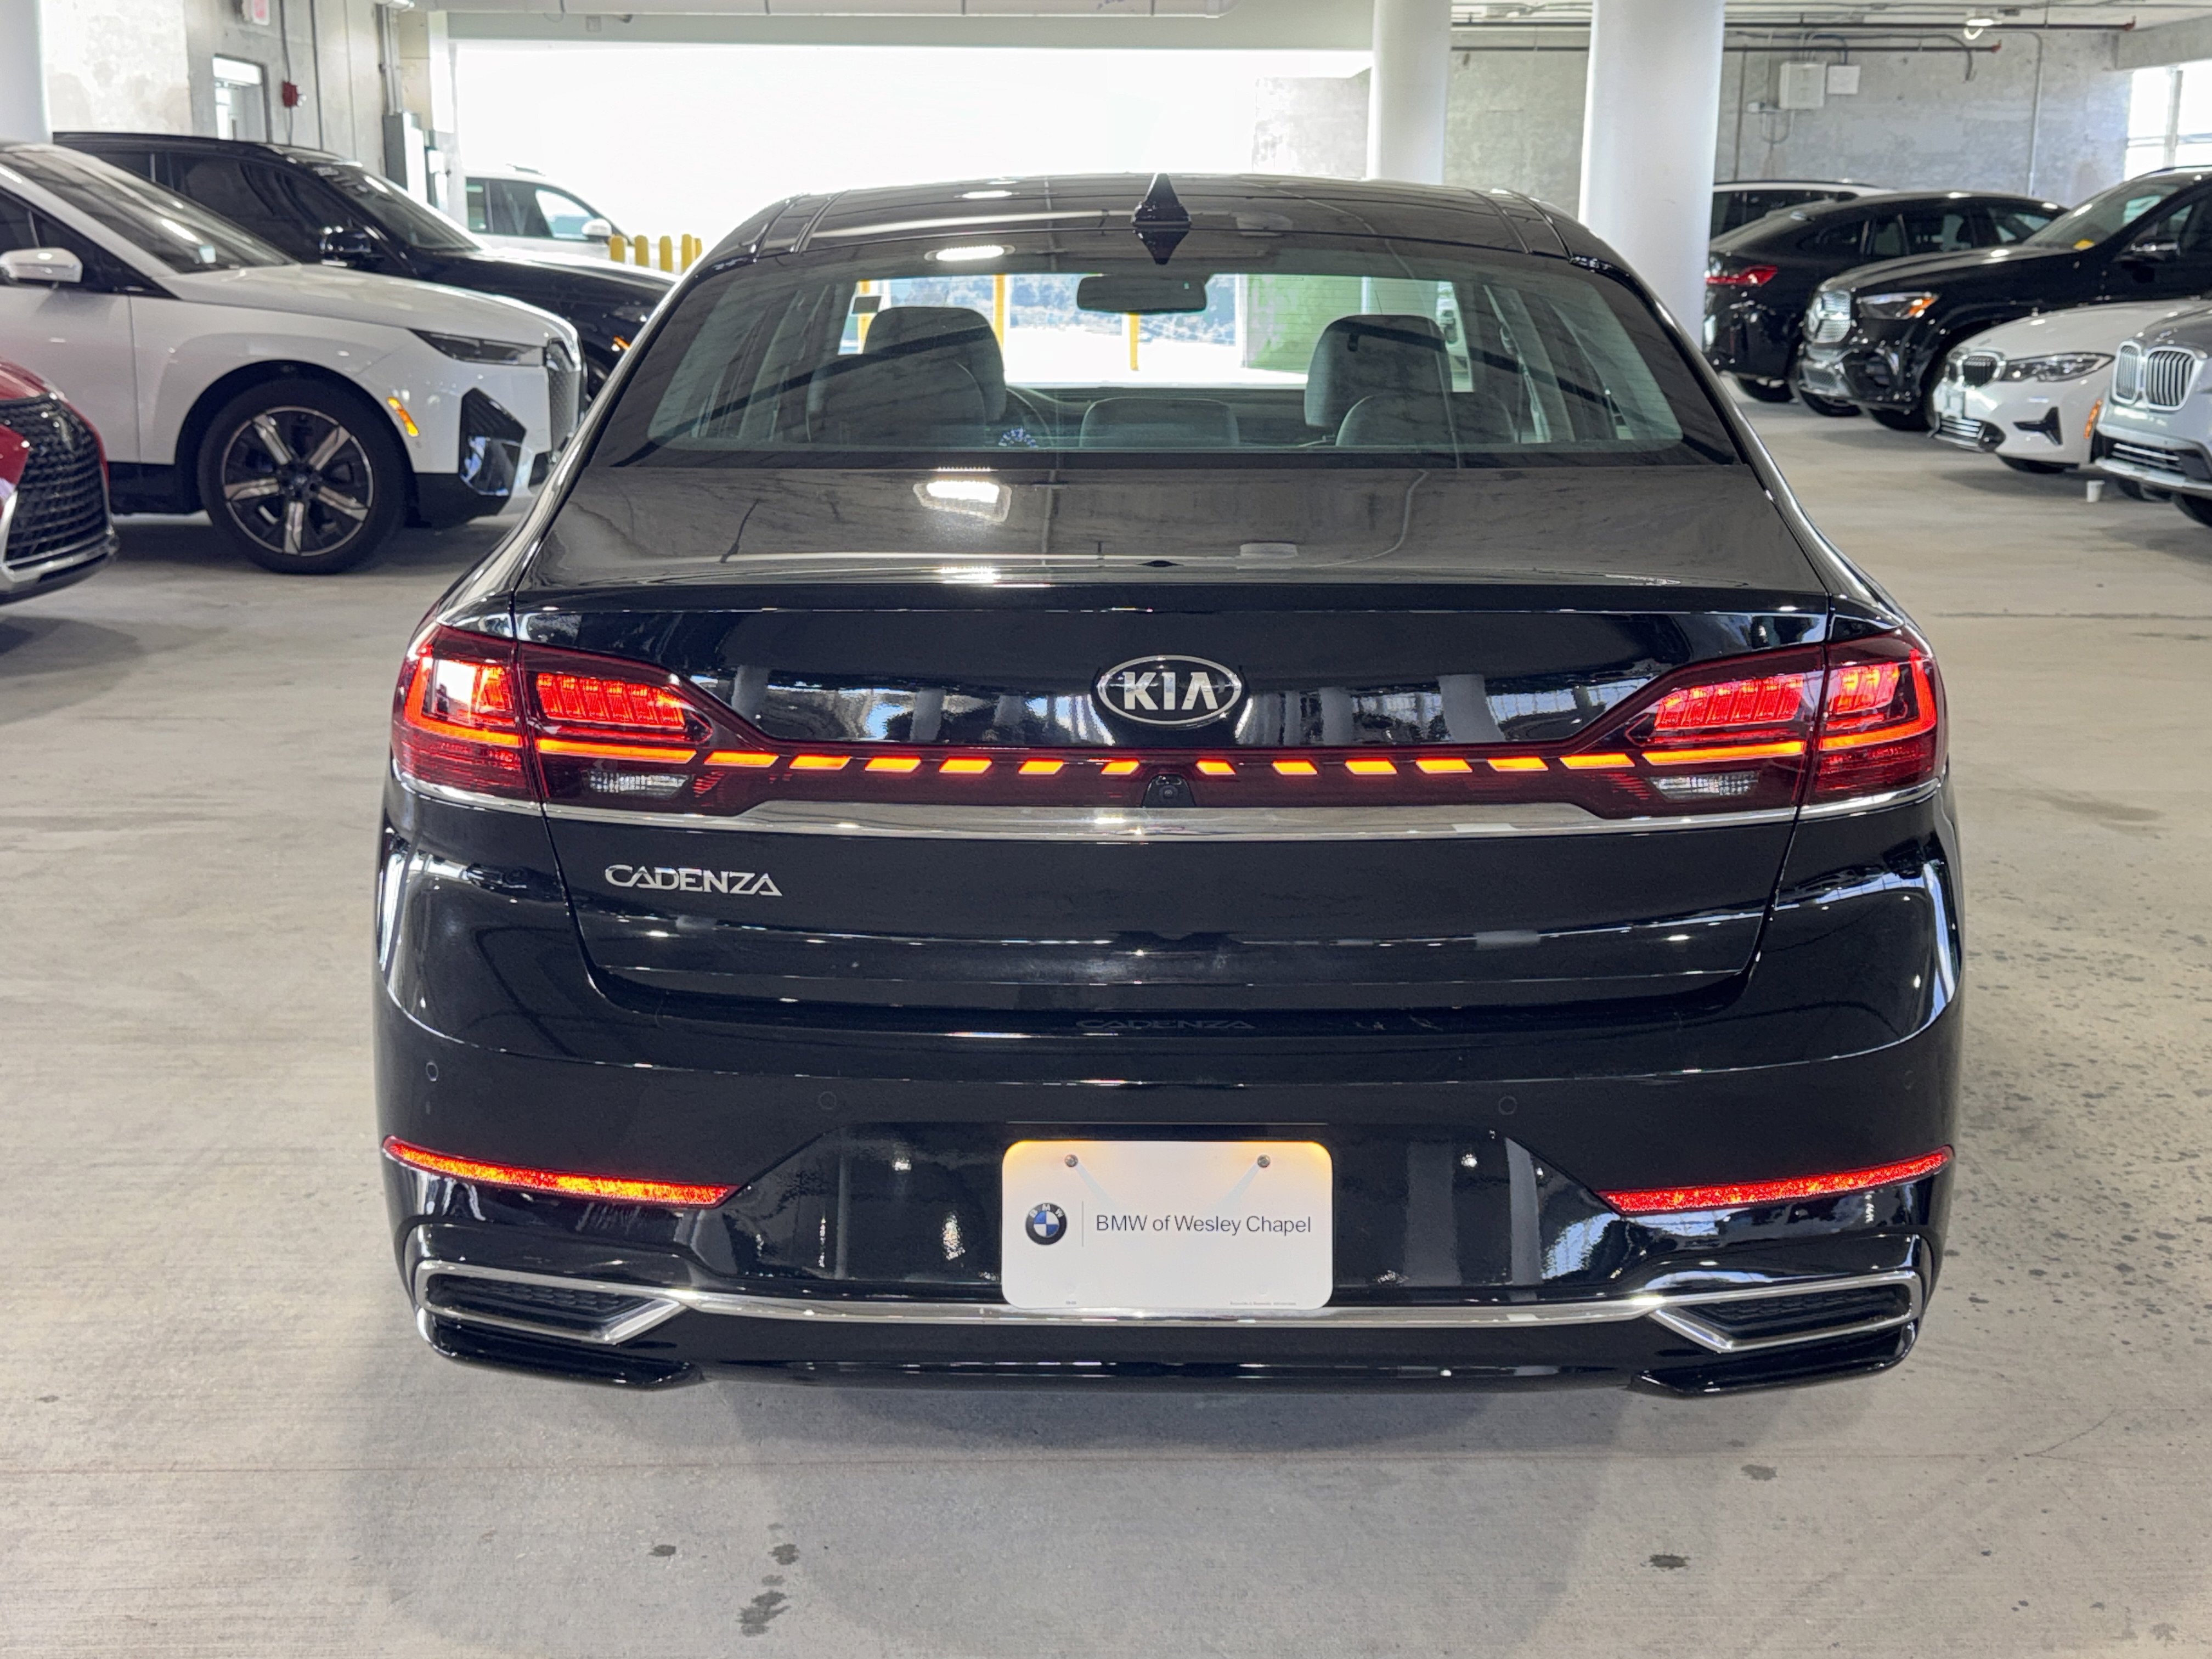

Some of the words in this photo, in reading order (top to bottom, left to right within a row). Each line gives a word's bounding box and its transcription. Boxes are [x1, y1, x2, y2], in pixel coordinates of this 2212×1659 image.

[1122, 672, 1218, 710] KIA
[605, 864, 782, 896] CADENZA
[1075, 1019, 1256, 1029] CADENZA
[1096, 1215, 1148, 1232] BMW
[1152, 1214, 1171, 1232] of
[1174, 1215, 1242, 1237] Wesley
[1246, 1215, 1311, 1237] Chapel
